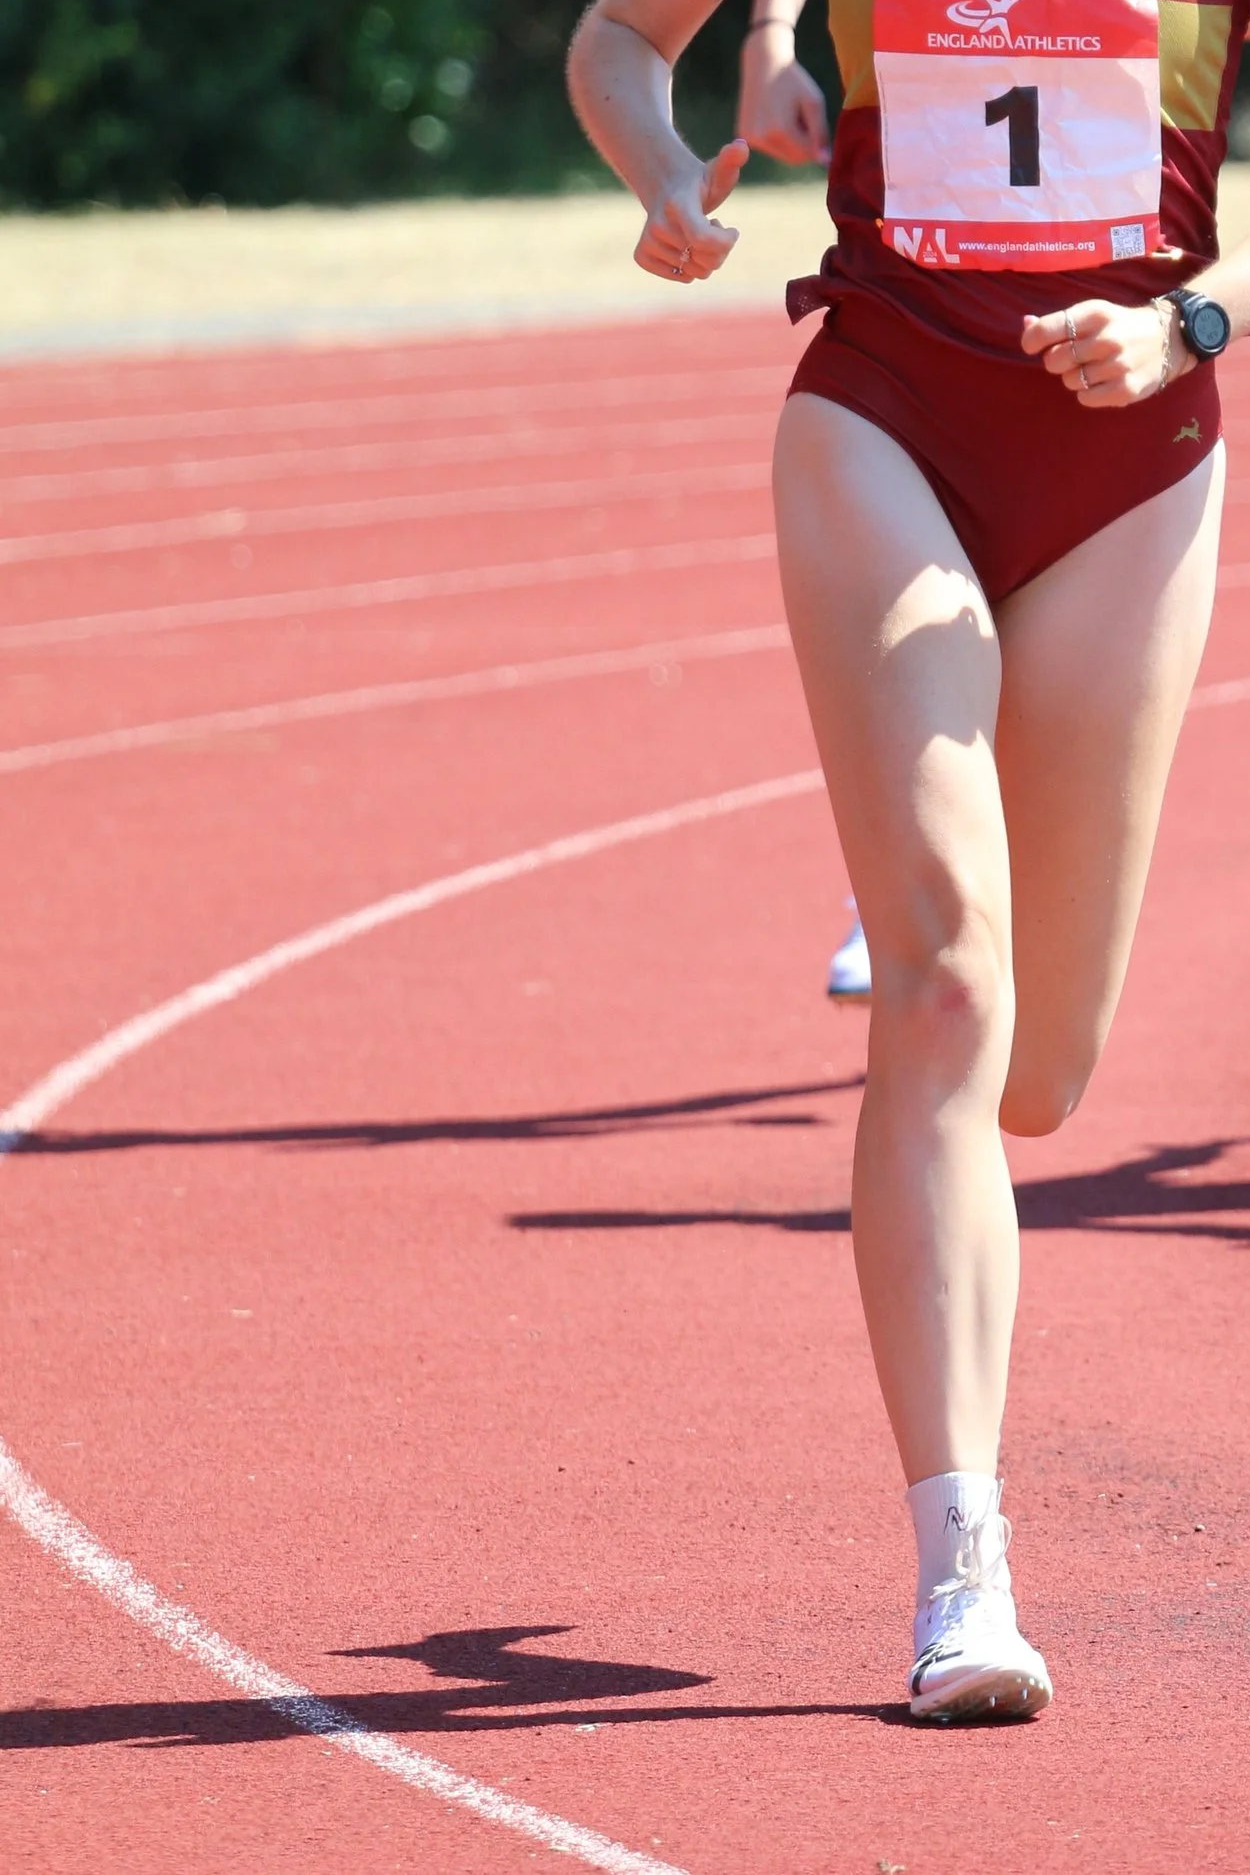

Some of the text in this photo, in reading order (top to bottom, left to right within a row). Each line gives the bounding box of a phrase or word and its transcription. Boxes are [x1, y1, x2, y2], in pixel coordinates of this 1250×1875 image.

[927, 32, 1101, 51] ENGLAND ATHLETICS
[984, 85, 1040, 187] 1
[958, 240, 1096, 254] www.englandathletics.org
